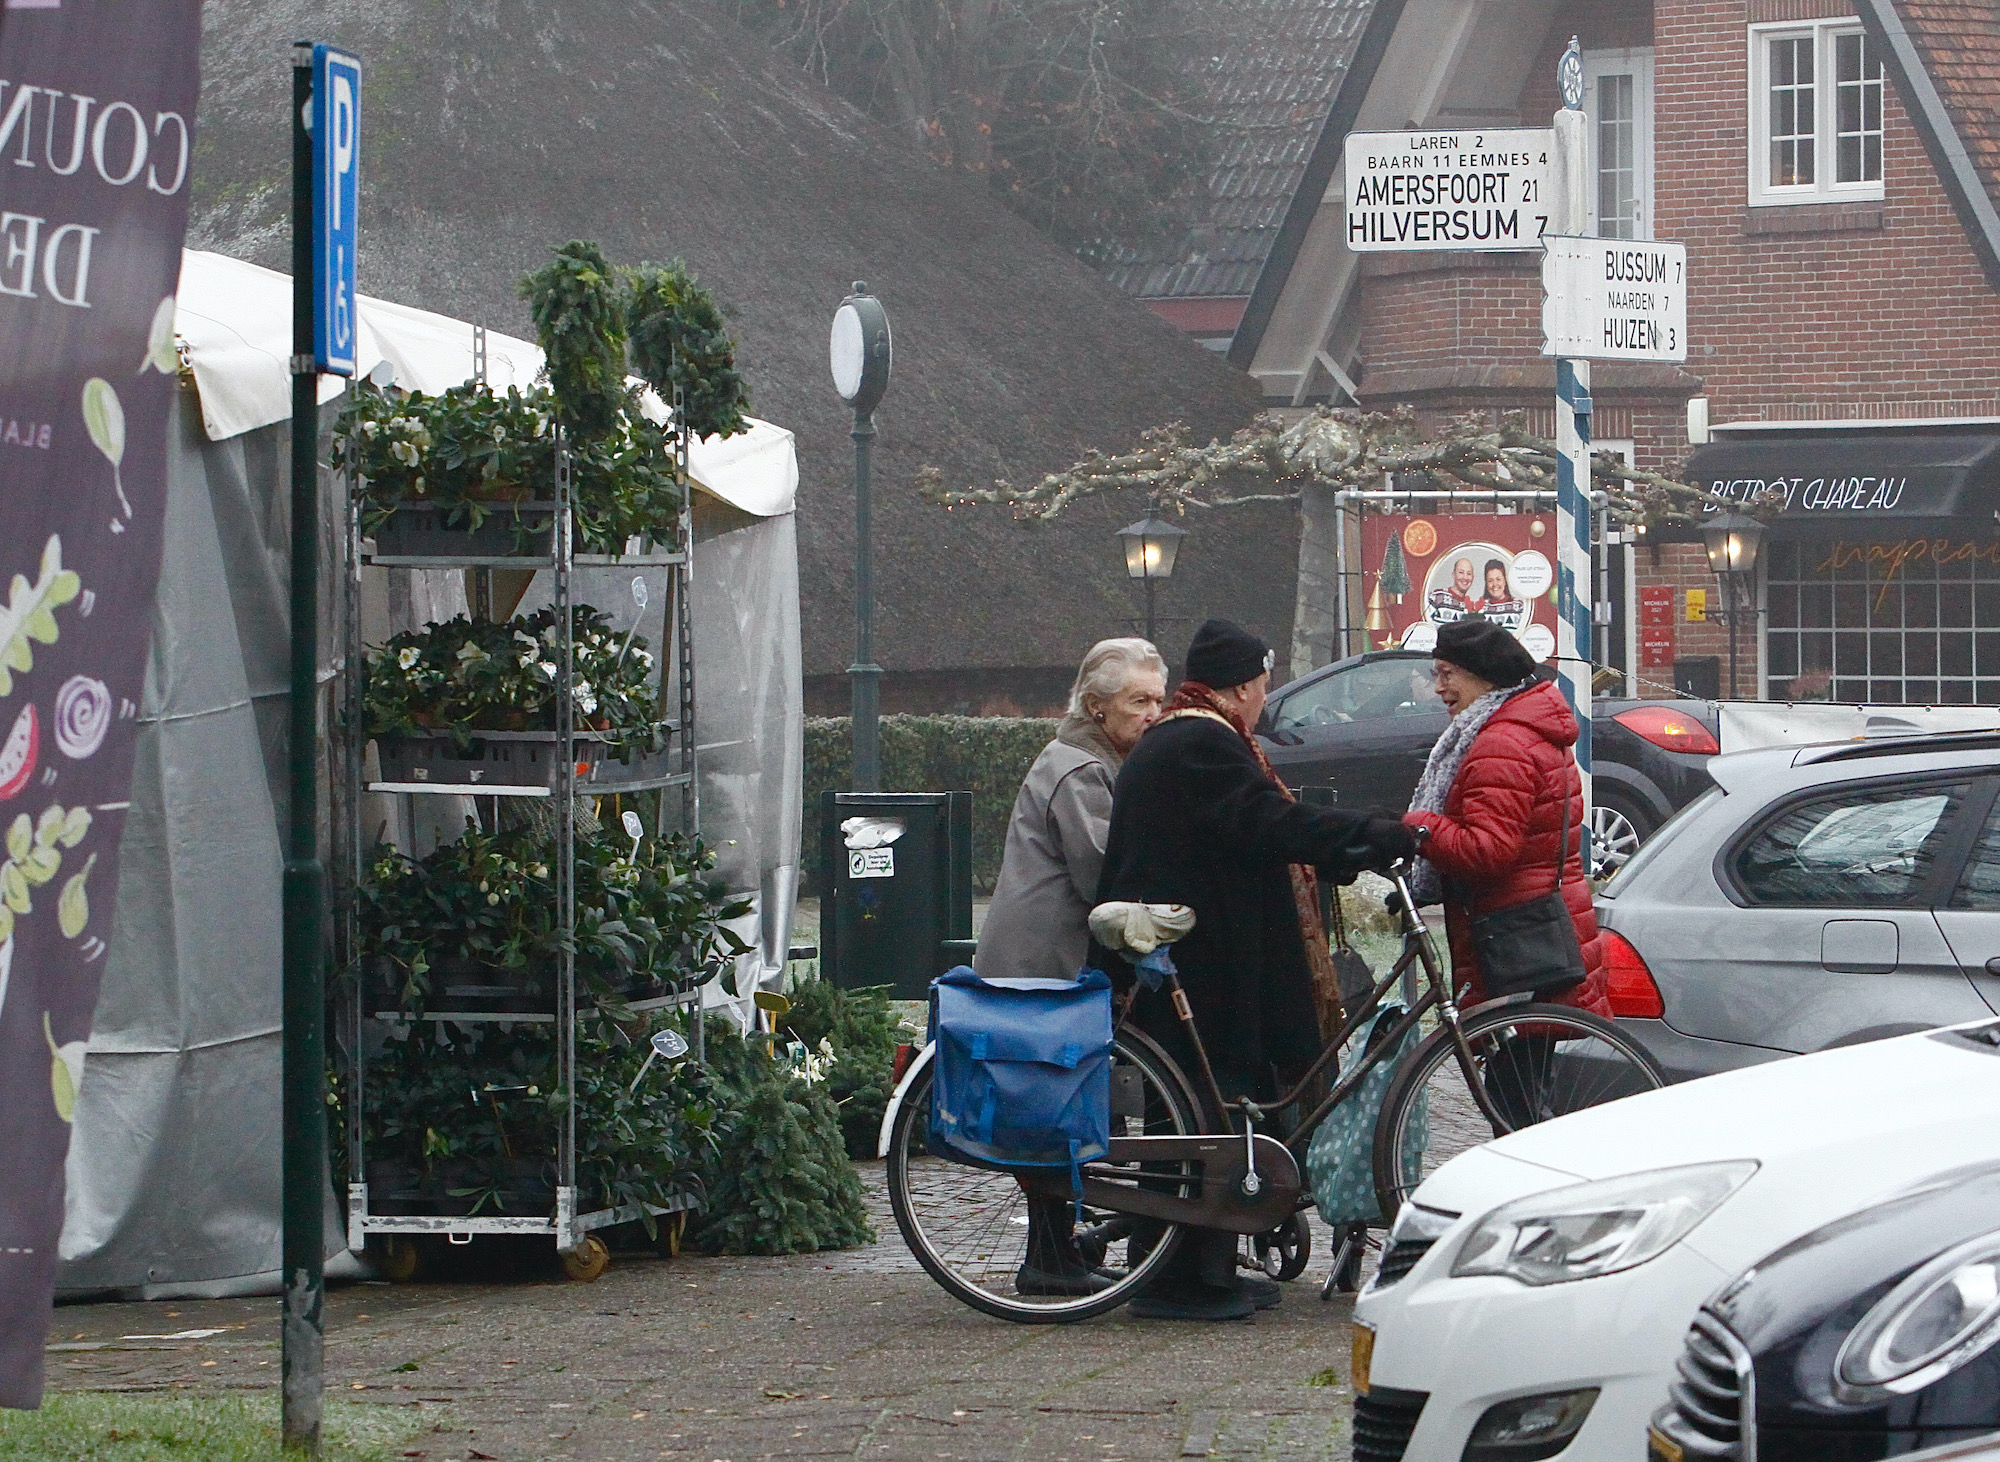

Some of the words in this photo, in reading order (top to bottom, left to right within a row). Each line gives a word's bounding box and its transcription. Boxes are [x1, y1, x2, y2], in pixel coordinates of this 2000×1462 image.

[1410, 136, 1458, 150] LAREN
[1475, 135, 1484, 148] 2
[1368, 155, 1424, 169] BAARN
[1433, 155, 1450, 168] 11
[1459, 152, 1530, 167] EEMNES
[1538, 152, 1548, 165] 4
[1355, 172, 1510, 206] AMERSFOORT
[1522, 179, 1539, 203] 21
[1349, 209, 1519, 242] HILVERSUM
[1534, 215, 1549, 239] 7
[1606, 250, 1666, 283] BUSSUM
[1675, 261, 1682, 284] 7
[1608, 291, 1655, 310] NAARDEN
[1663, 296, 1669, 311] 7
[1603, 318, 1658, 350] HUIZEN
[1668, 327, 1676, 351] 3
[1802, 477, 1906, 510] CHAPEAU
